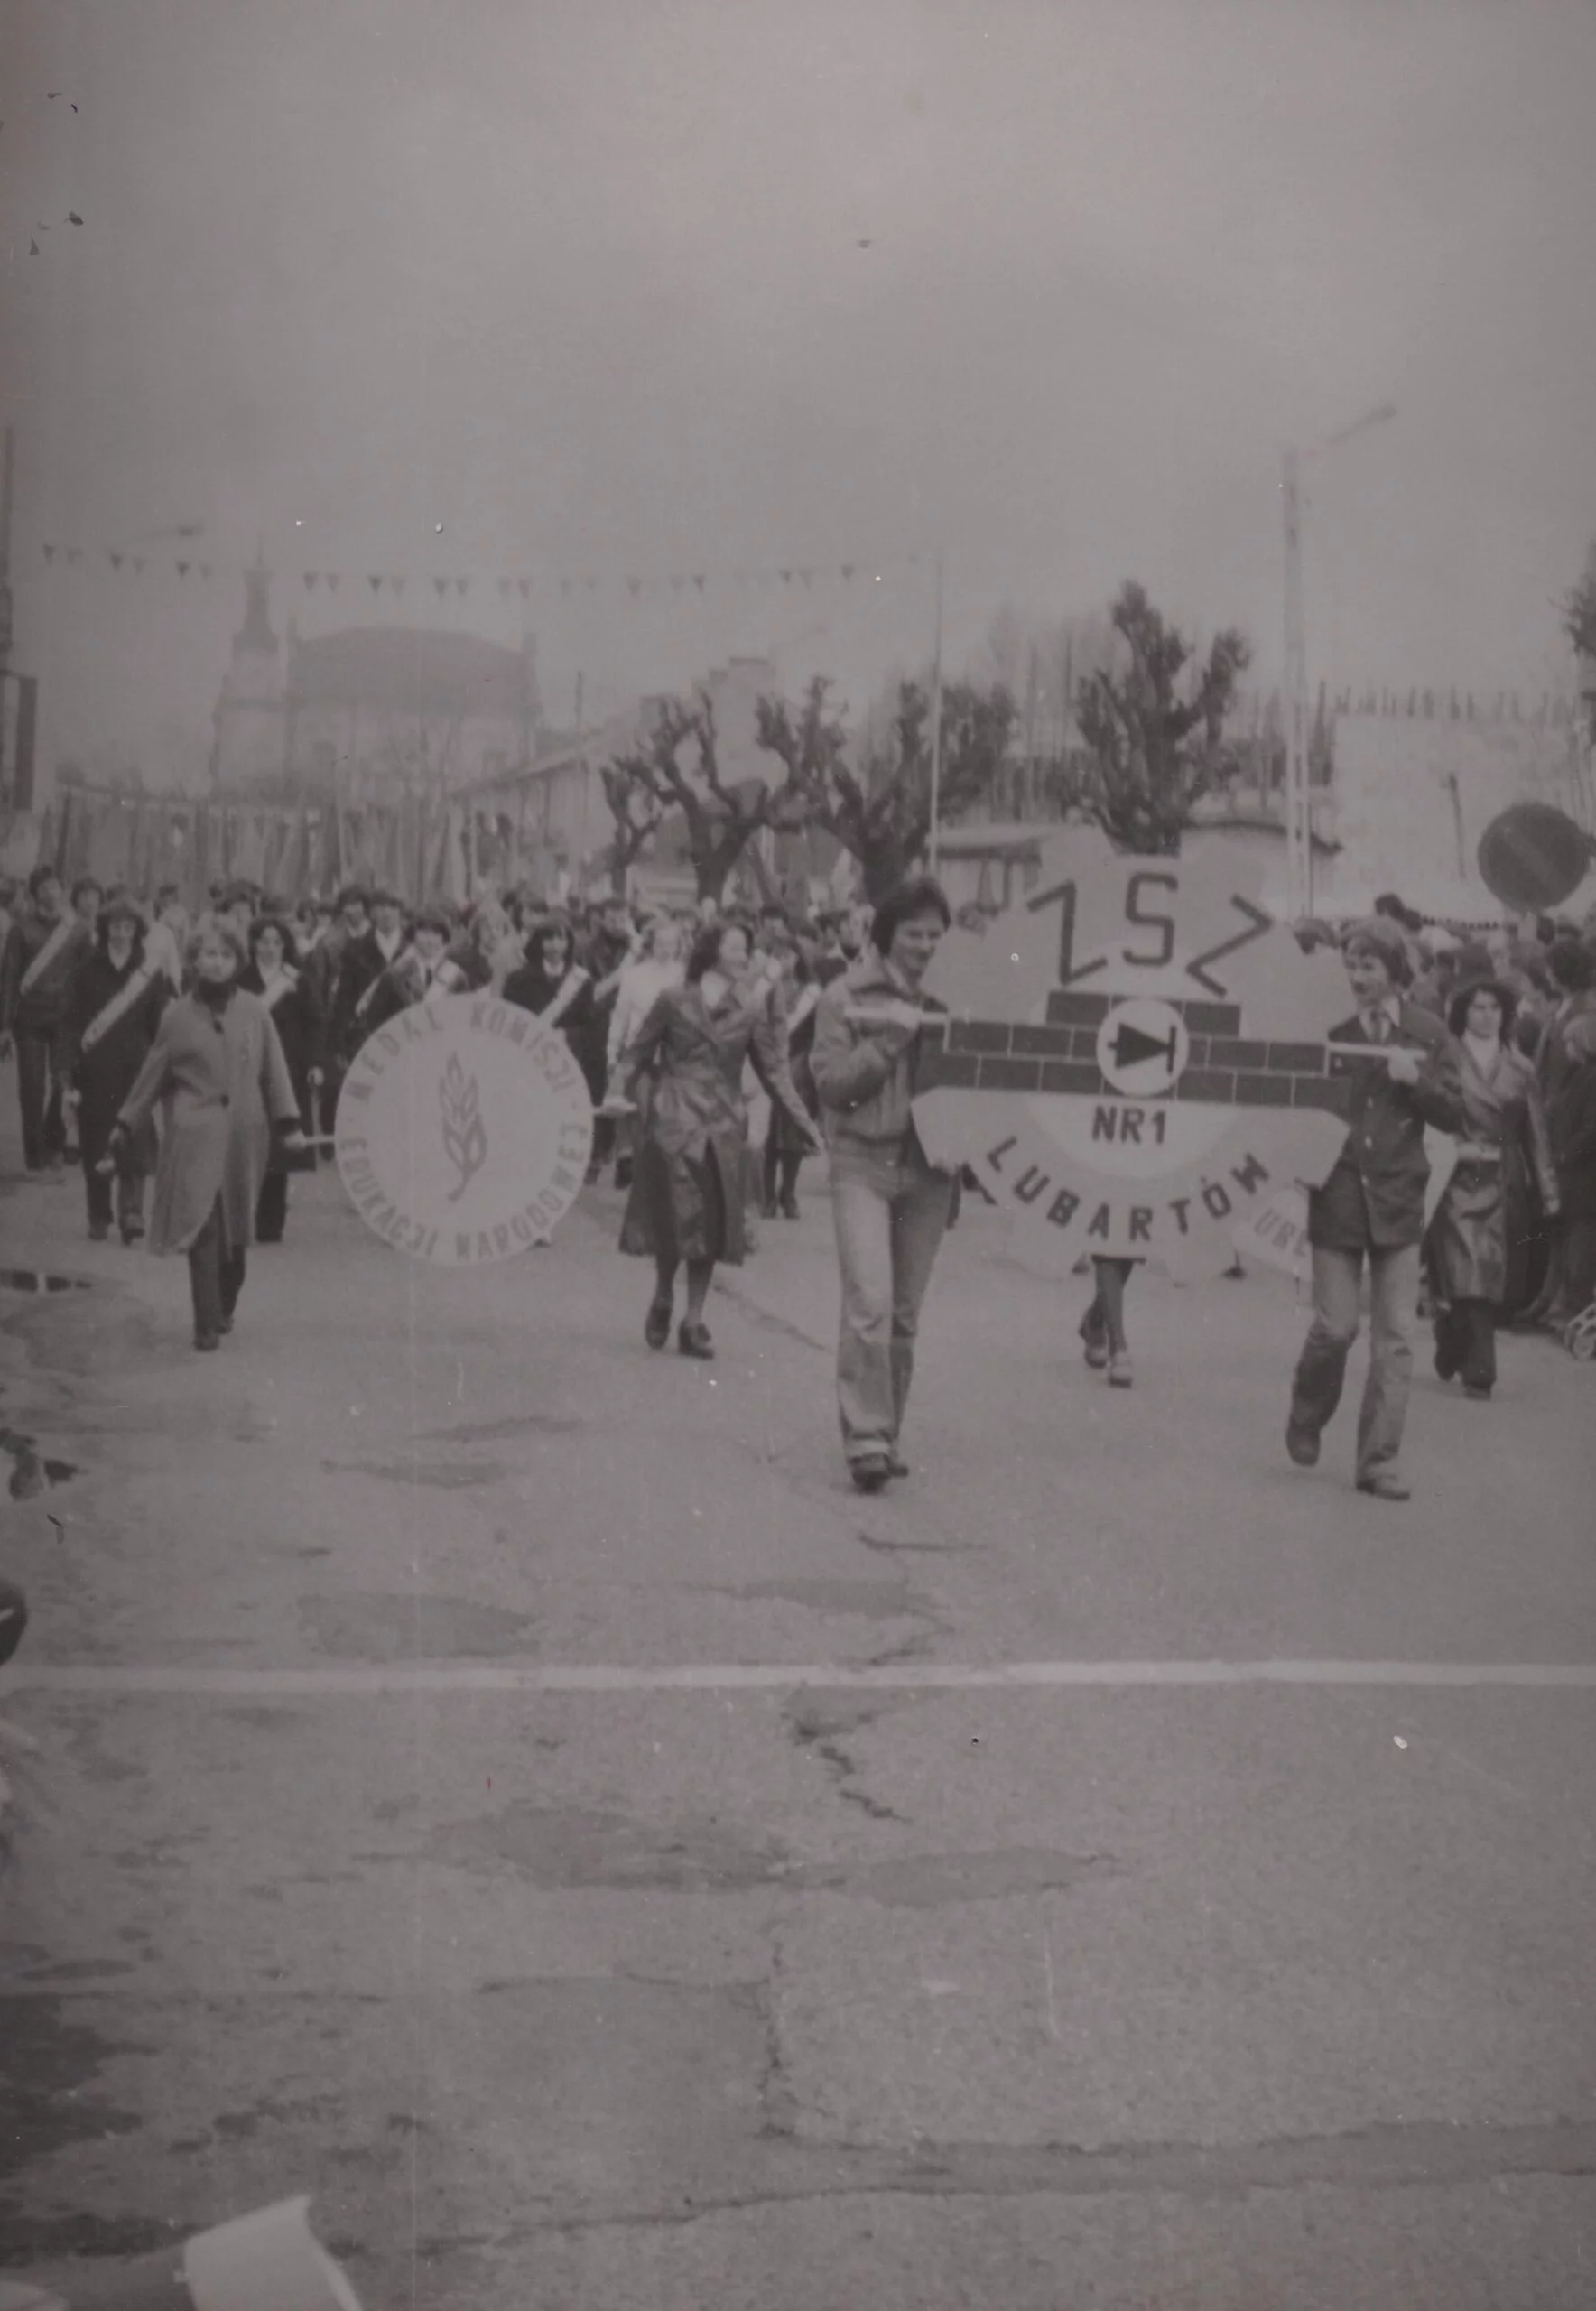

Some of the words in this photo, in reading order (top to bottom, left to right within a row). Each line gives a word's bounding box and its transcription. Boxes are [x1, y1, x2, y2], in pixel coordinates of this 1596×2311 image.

[345, 1004, 444, 1107] MEDAL
[470, 1001, 576, 1093] KOMISJI
[339, 1136, 438, 1256] EDUKACJI
[456, 1124, 588, 1260] NARODOWEJ
[988, 1136, 1269, 1243] LUBARTÓW
